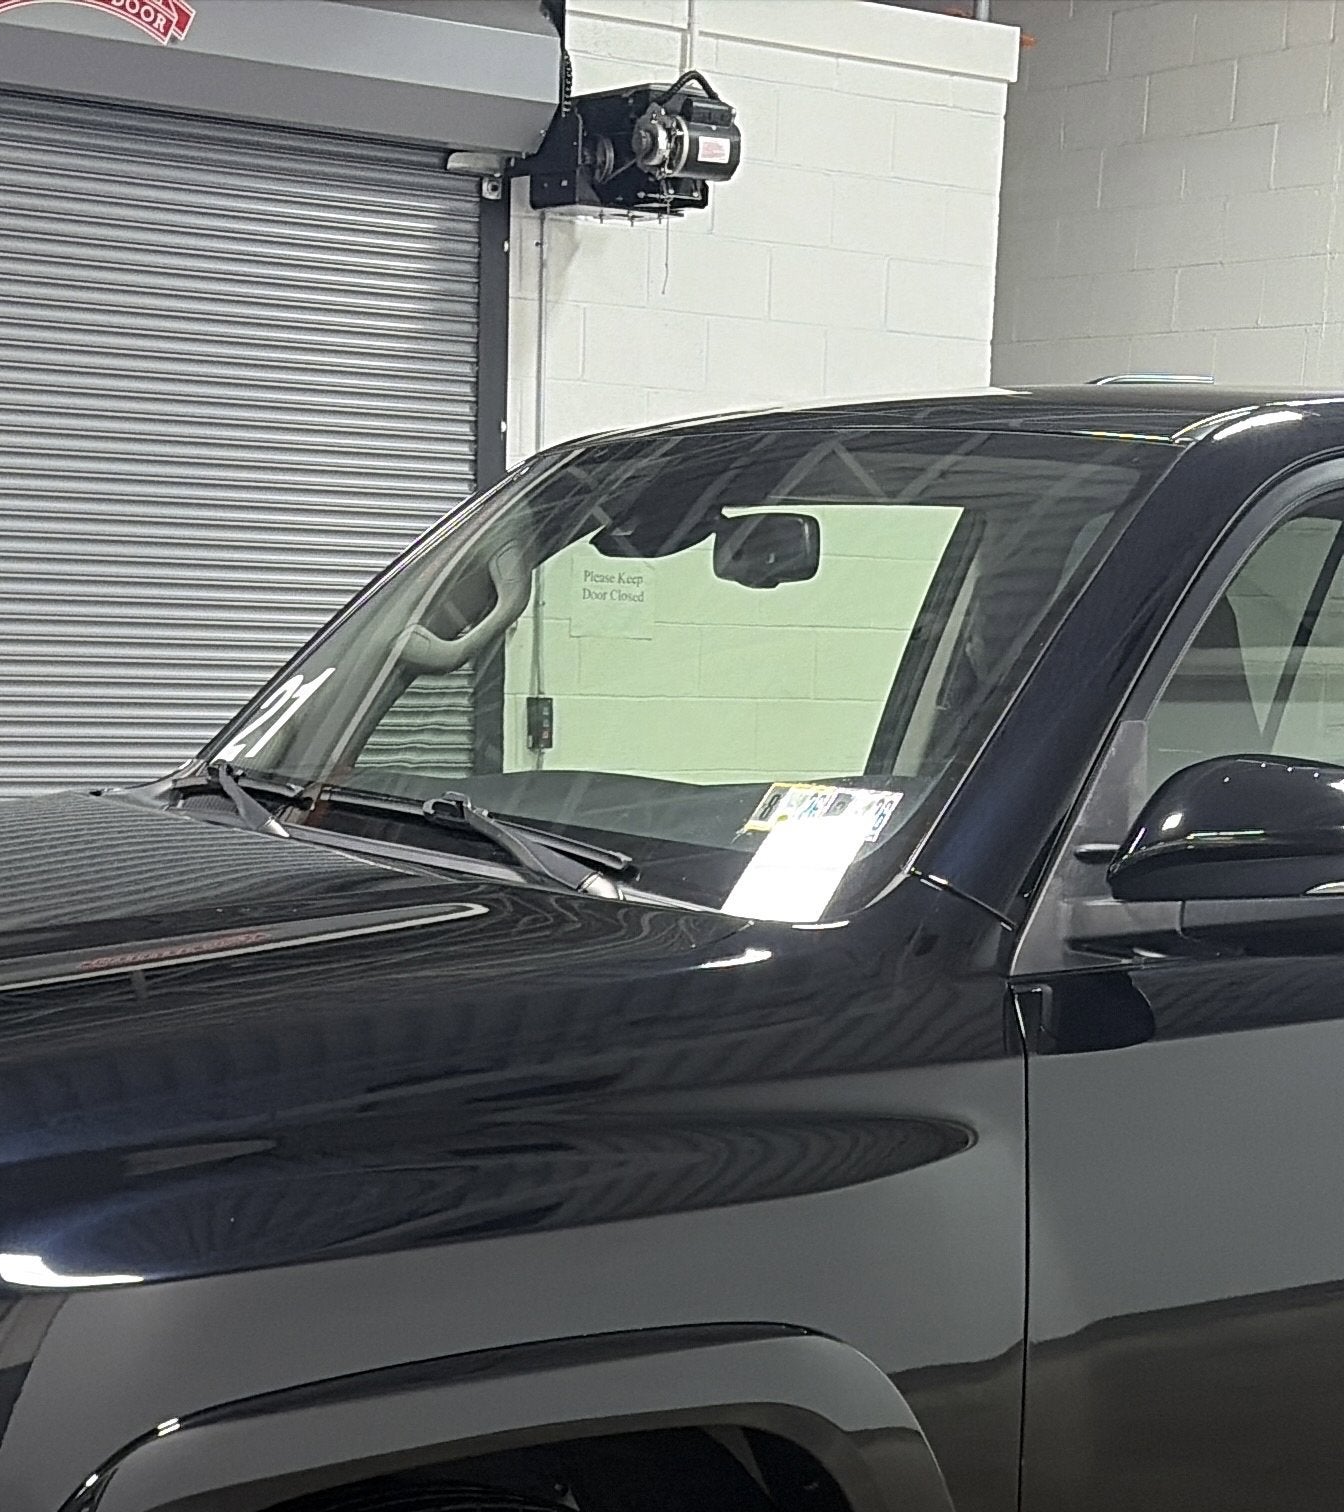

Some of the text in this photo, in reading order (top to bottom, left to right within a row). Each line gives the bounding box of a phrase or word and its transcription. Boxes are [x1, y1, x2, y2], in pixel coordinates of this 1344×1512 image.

[583, 569, 644, 588] Please Keep
[582, 587, 645, 602] Door Closed
[209, 667, 337, 765] 21
